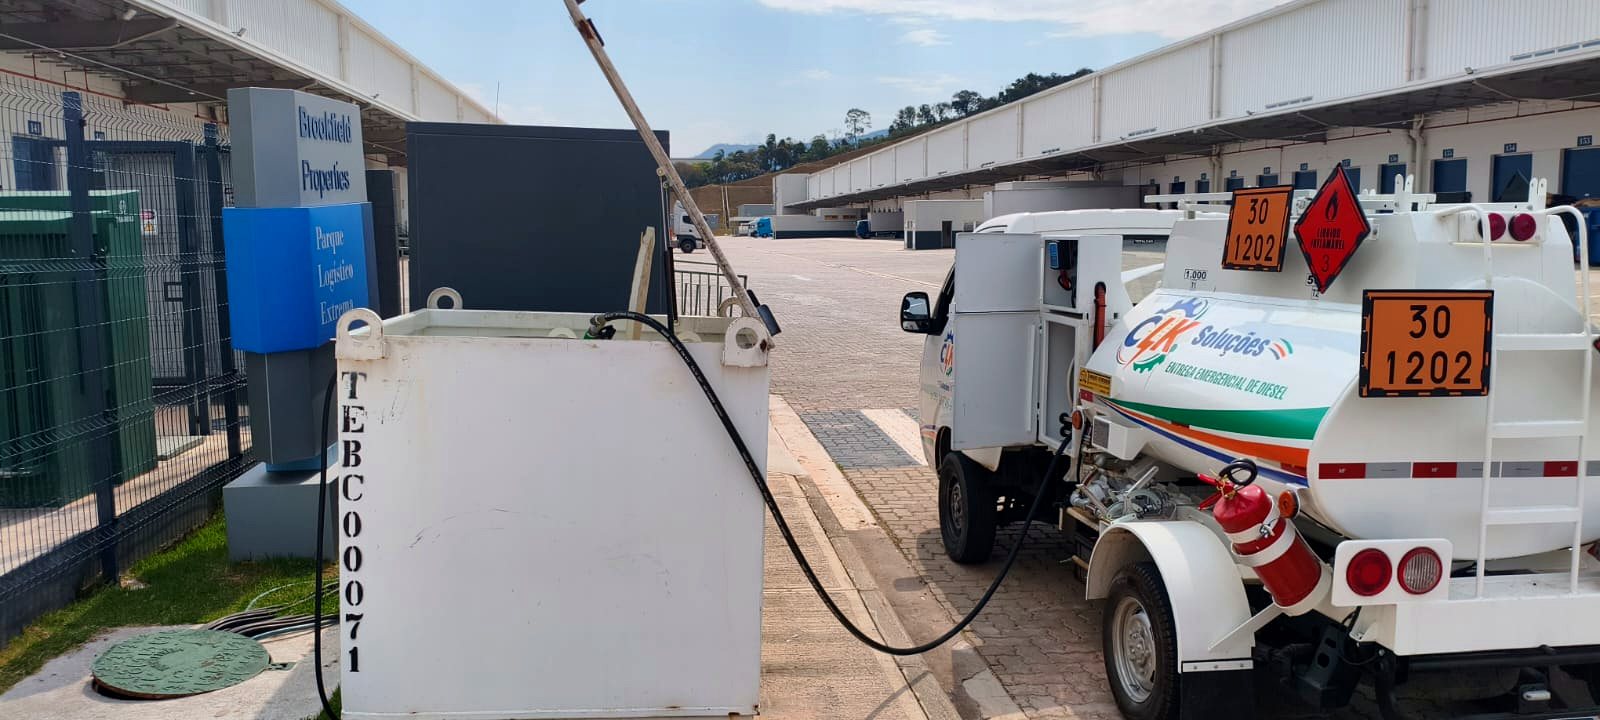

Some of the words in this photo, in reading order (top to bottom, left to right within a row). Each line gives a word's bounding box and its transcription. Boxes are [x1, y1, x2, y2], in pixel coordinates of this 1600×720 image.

[299, 106, 353, 144] Brookfield
[302, 160, 350, 199] Properties
[1248, 198, 1269, 225] 30
[315, 226, 344, 254] Parque
[1234, 234, 1275, 262] 1202
[318, 259, 353, 292] Logístico
[1186, 270, 1207, 280] 1.000
[1321, 254, 1330, 272] 3
[320, 299, 354, 325] Extrema
[1409, 304, 1450, 339] 30
[1191, 325, 1271, 357] Soluções
[1165, 361, 1197, 379] ENTREGA
[1193, 366, 1248, 391] EMERGENCIAL
[1244, 379, 1261, 394] DE
[1256, 381, 1289, 401] DIESEL
[1387, 351, 1472, 385] 1202
[341, 371, 367, 673] TEBC00071
